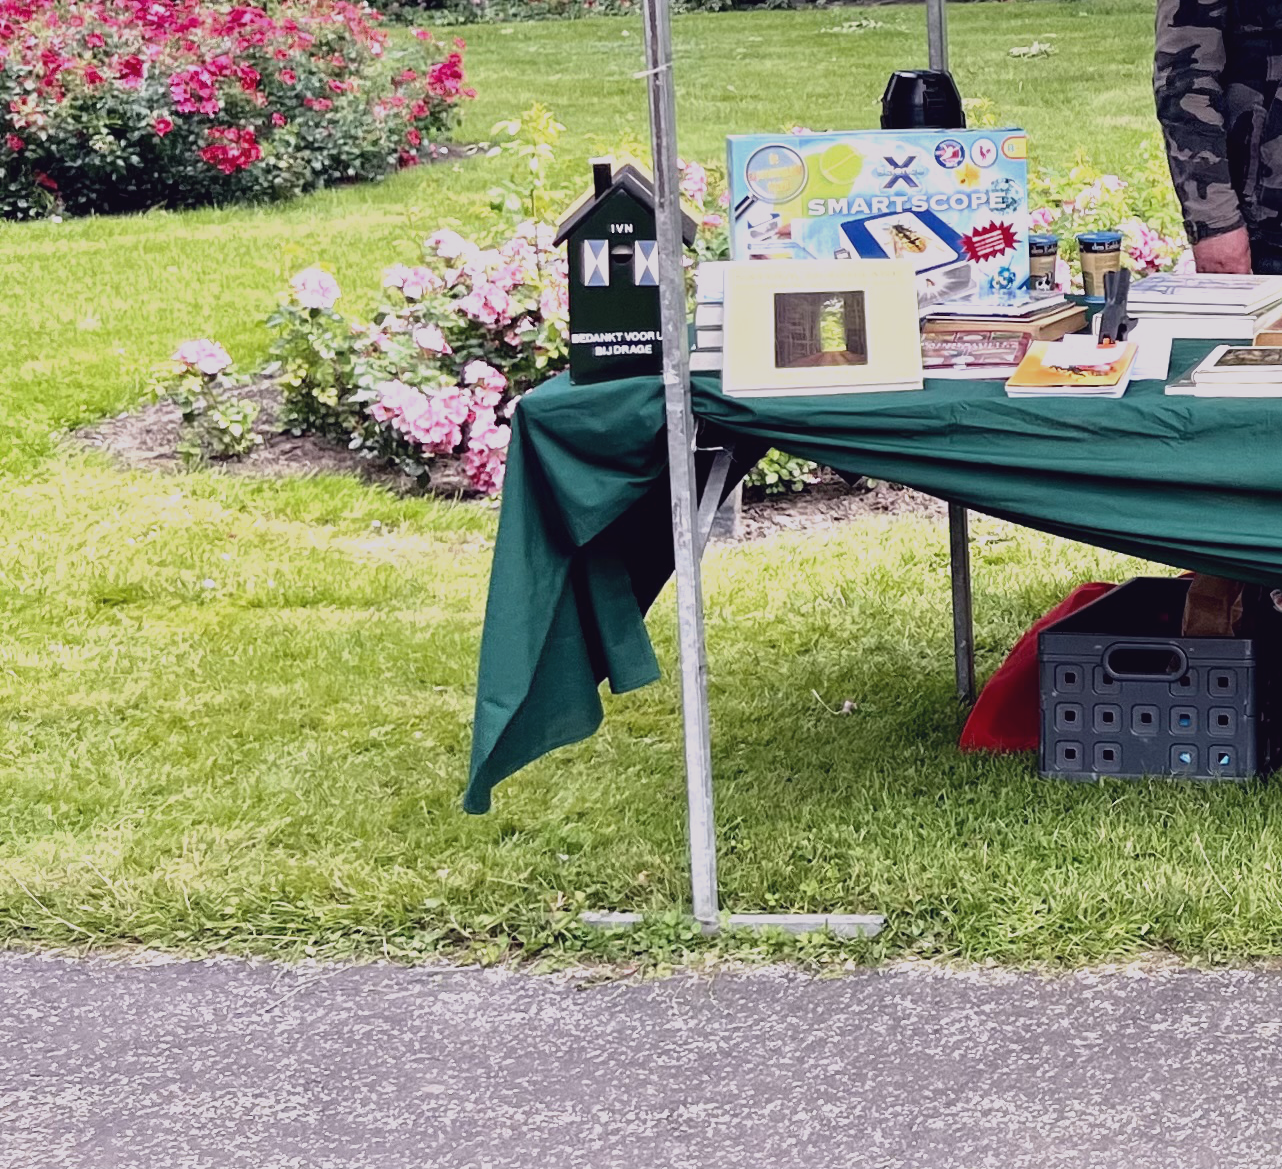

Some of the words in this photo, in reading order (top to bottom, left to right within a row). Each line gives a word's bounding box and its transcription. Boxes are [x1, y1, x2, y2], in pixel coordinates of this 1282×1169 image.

[610, 223, 633, 234] IVN
[571, 332, 622, 344] BEDANKT
[624, 331, 655, 342] VOOR
